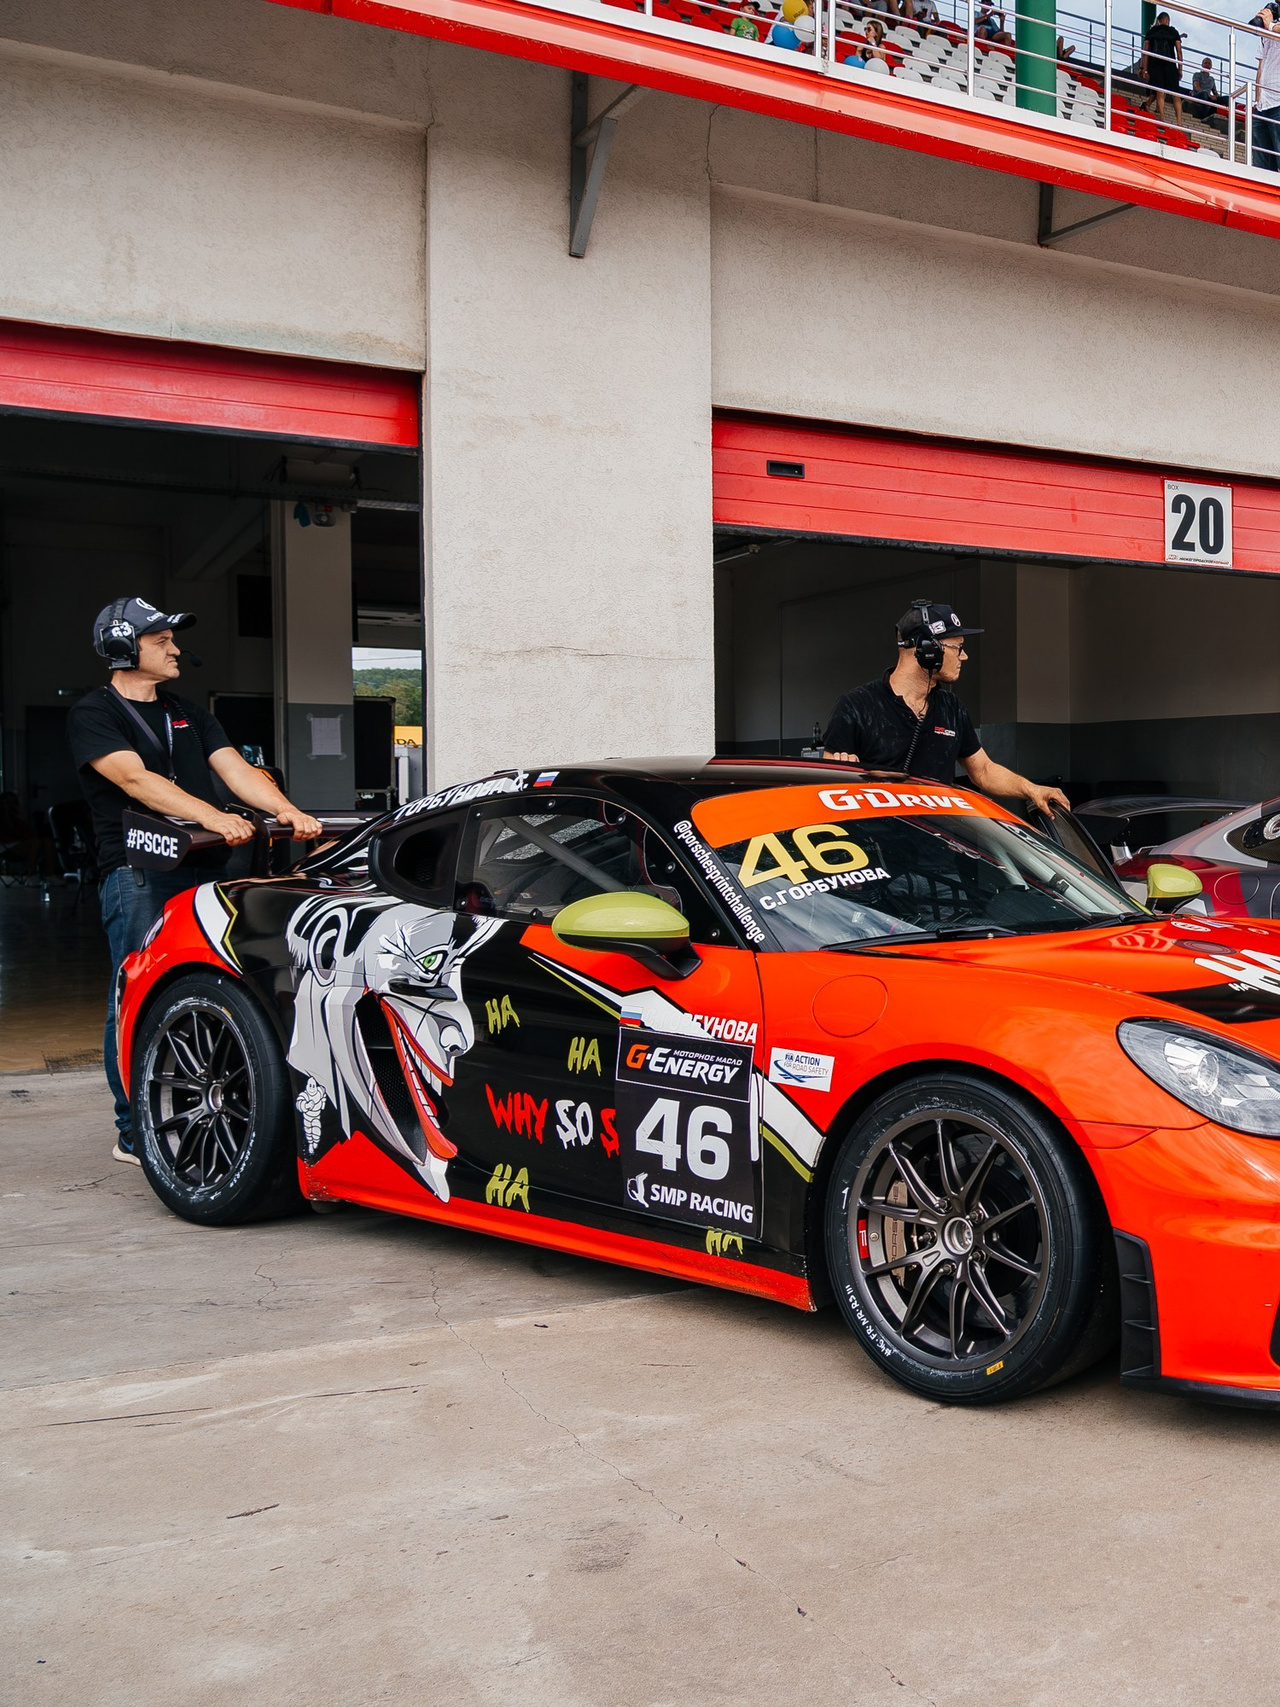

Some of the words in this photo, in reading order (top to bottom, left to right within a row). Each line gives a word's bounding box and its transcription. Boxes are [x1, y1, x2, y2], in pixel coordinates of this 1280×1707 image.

[1171, 493, 1225, 555] 20
[126, 827, 179, 860] #PSCCE
[737, 823, 870, 889] 46
[673, 819, 767, 945] @porschesprintchallenge
[759, 867, 891, 911] С.ГОРБУНОВА
[485, 994, 520, 1035] HA
[568, 1036, 602, 1077] HA
[673, 1049, 715, 1062] МОТОРНОЕ
[716, 1056, 744, 1067] МАСЛО
[792, 1063, 808, 1072] ROAD
[808, 1066, 829, 1076] SAFETY
[794, 1055, 820, 1067] ACTION
[485, 1083, 549, 1145] WHY
[635, 1097, 733, 1181] 46
[485, 1163, 531, 1213] HA
[650, 1183, 688, 1207] SMP
[689, 1191, 754, 1224] RACING
